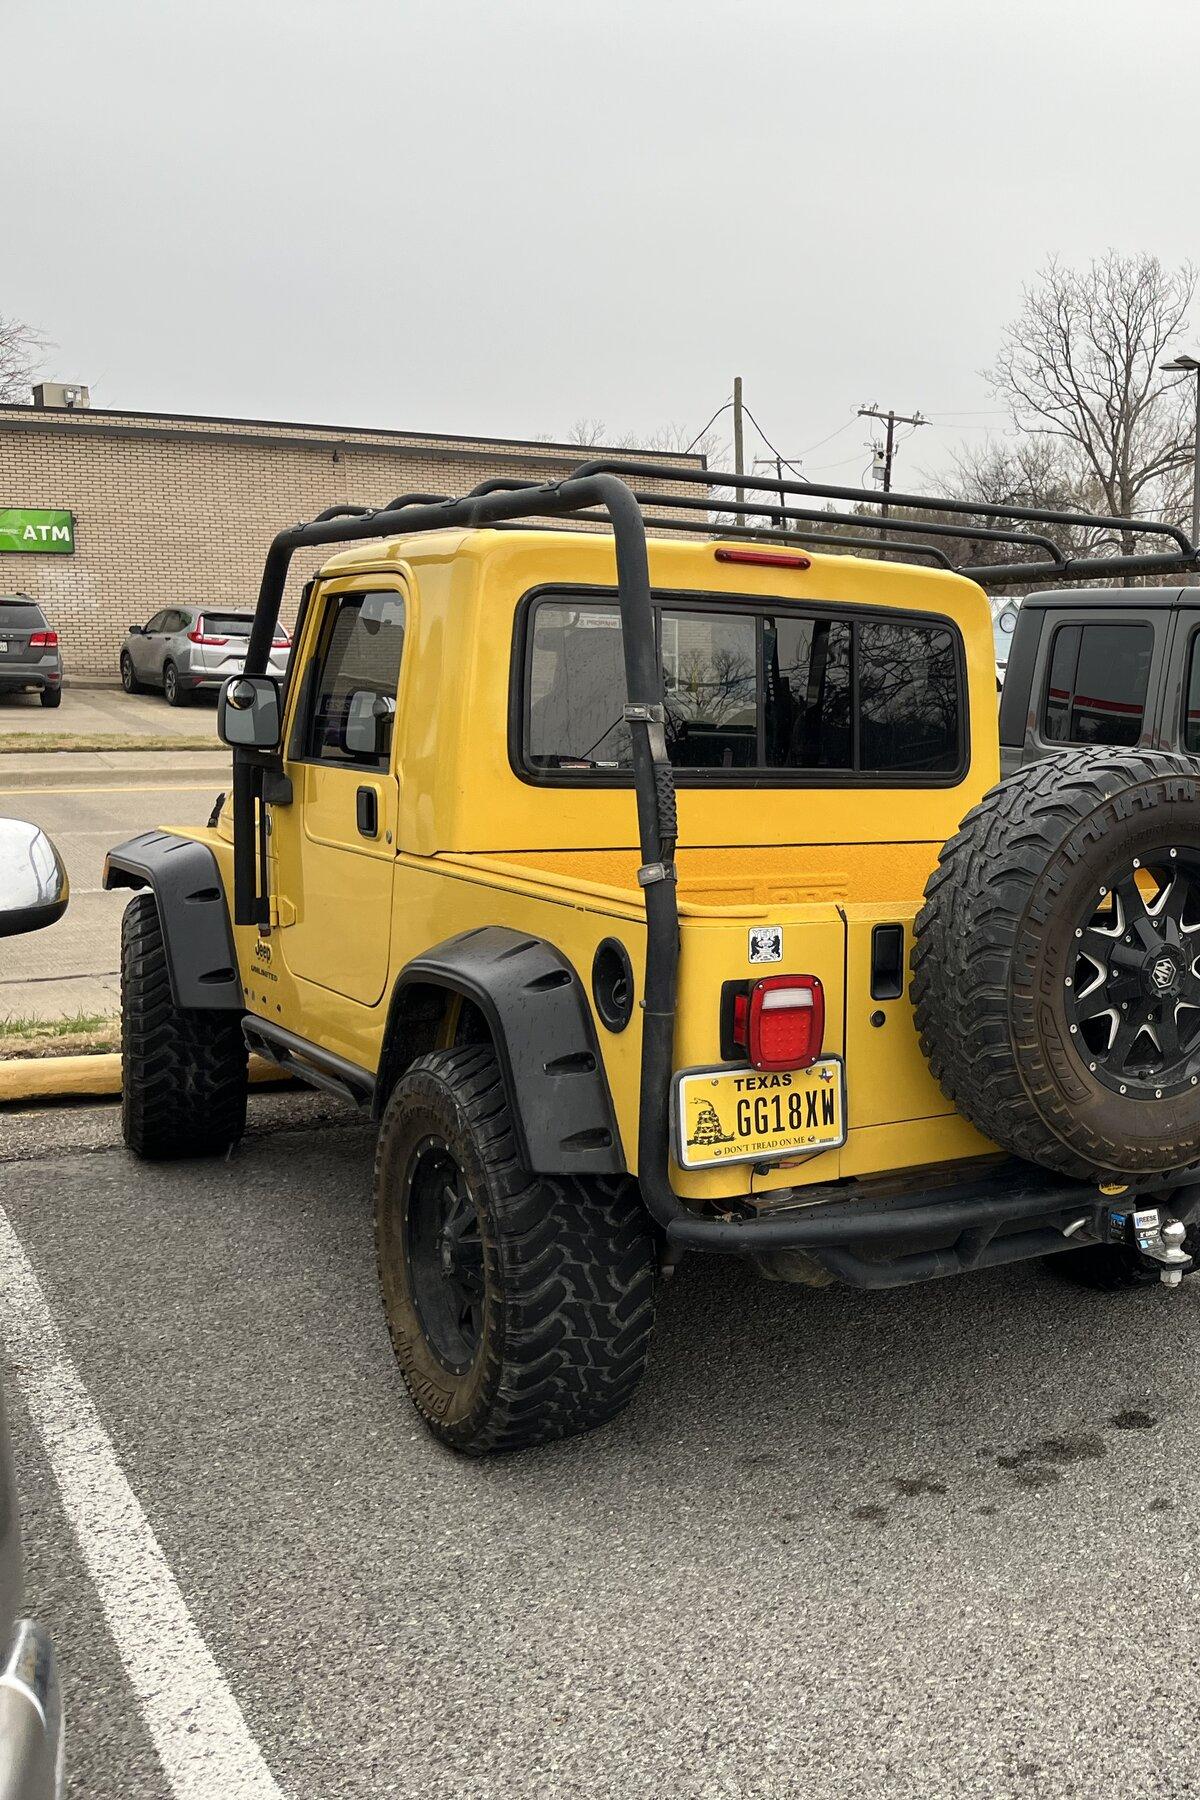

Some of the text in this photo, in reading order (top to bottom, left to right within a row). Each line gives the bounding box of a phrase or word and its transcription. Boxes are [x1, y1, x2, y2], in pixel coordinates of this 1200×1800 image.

[23, 525, 70, 542] ATM
[752, 929, 778, 938] YETI
[255, 938, 272, 964] Jeep
[734, 1073, 792, 1092] TEXAS
[737, 1088, 834, 1137] GG18XW
[724, 1135, 806, 1155] DON'T TREAD ON ME
